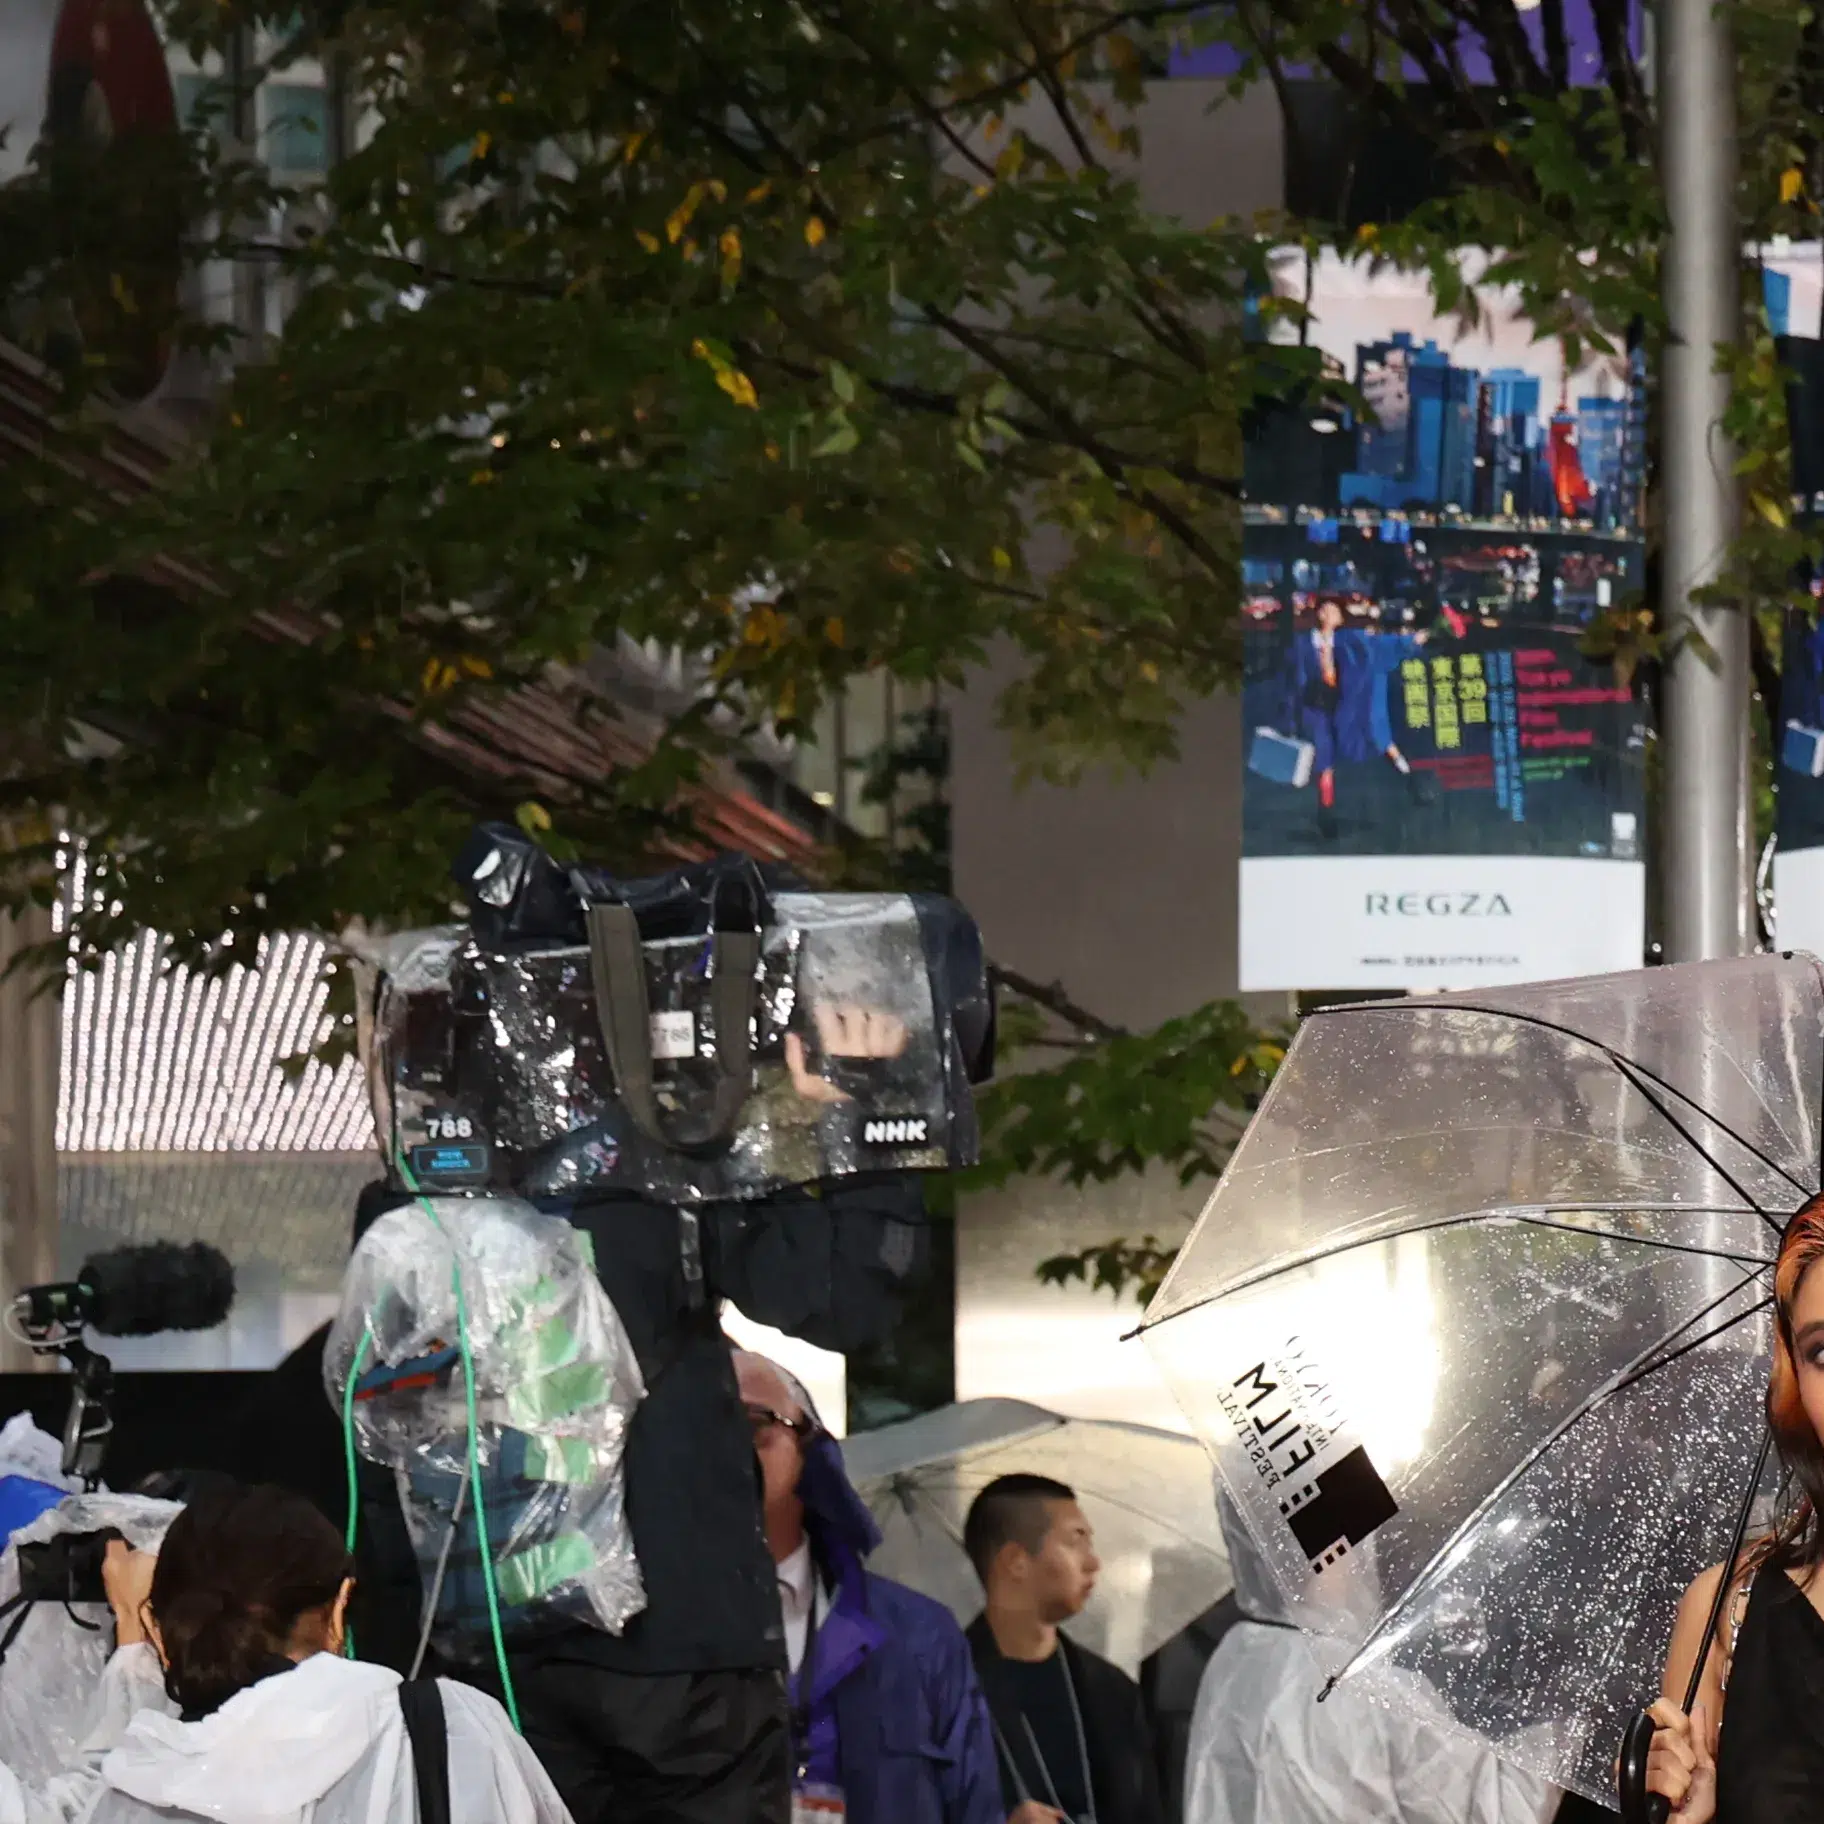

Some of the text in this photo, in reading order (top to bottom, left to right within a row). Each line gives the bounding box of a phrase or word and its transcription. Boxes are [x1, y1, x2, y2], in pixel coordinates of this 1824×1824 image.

[1365, 892, 1512, 916] REGZA
[425, 1117, 473, 1139] 788
[865, 1120, 927, 1143] NHK
